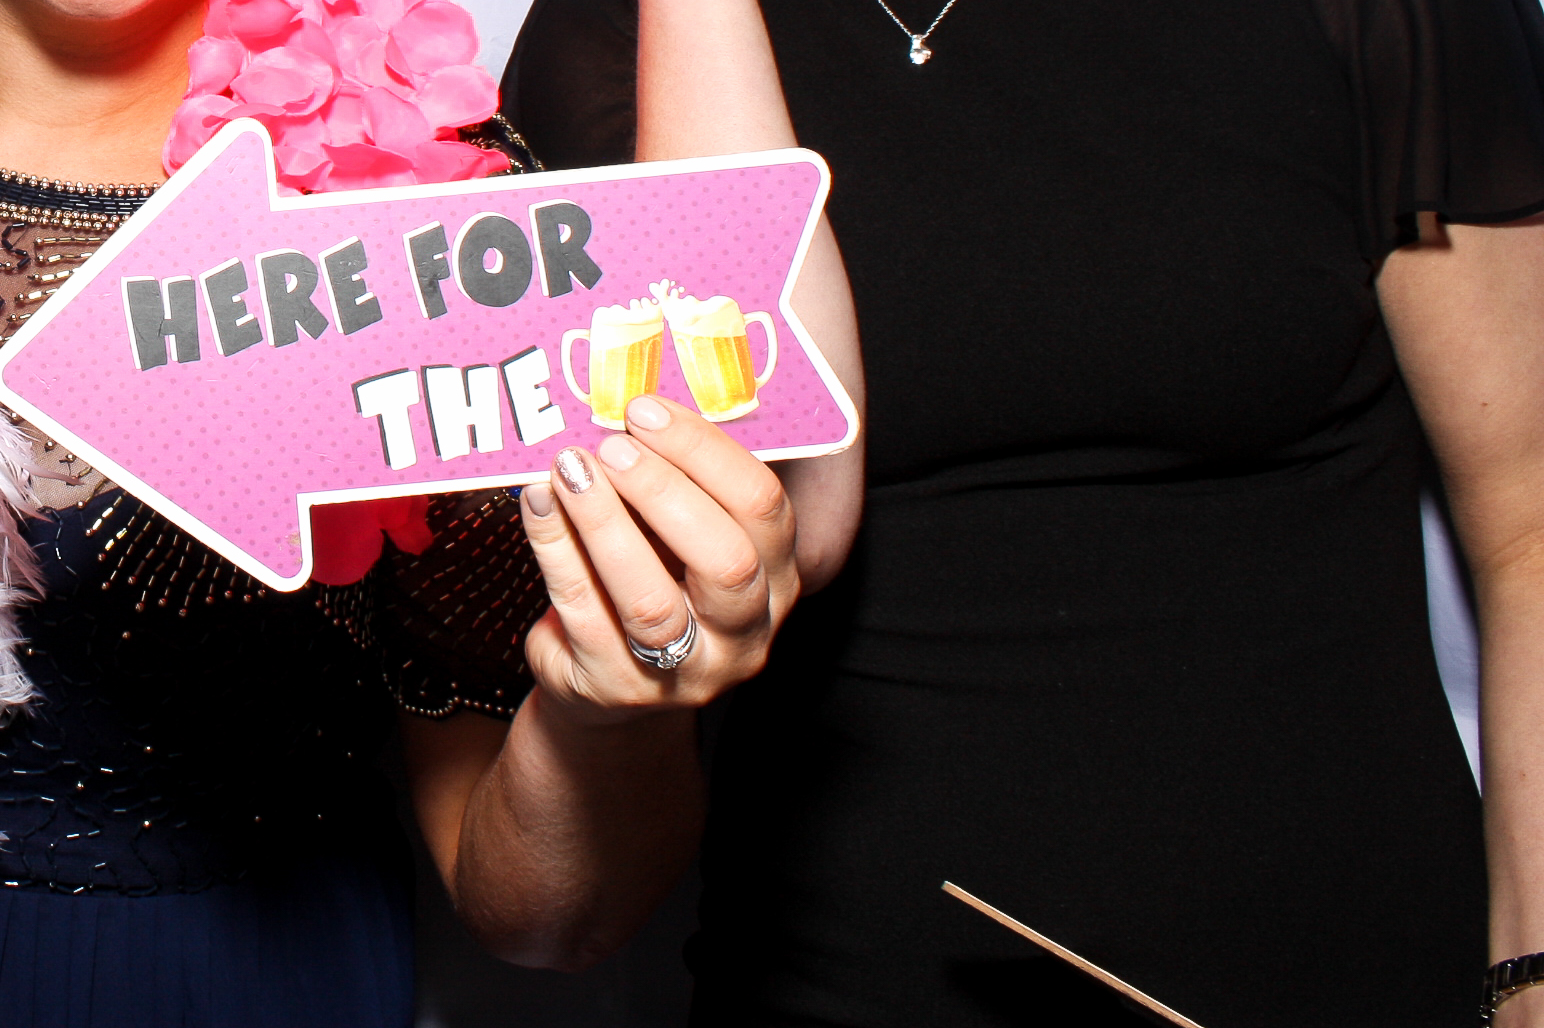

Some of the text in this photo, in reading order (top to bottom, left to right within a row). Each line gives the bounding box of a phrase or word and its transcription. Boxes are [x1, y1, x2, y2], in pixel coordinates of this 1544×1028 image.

[121, 198, 603, 371] HERE FOR
[352, 345, 565, 471] THE
